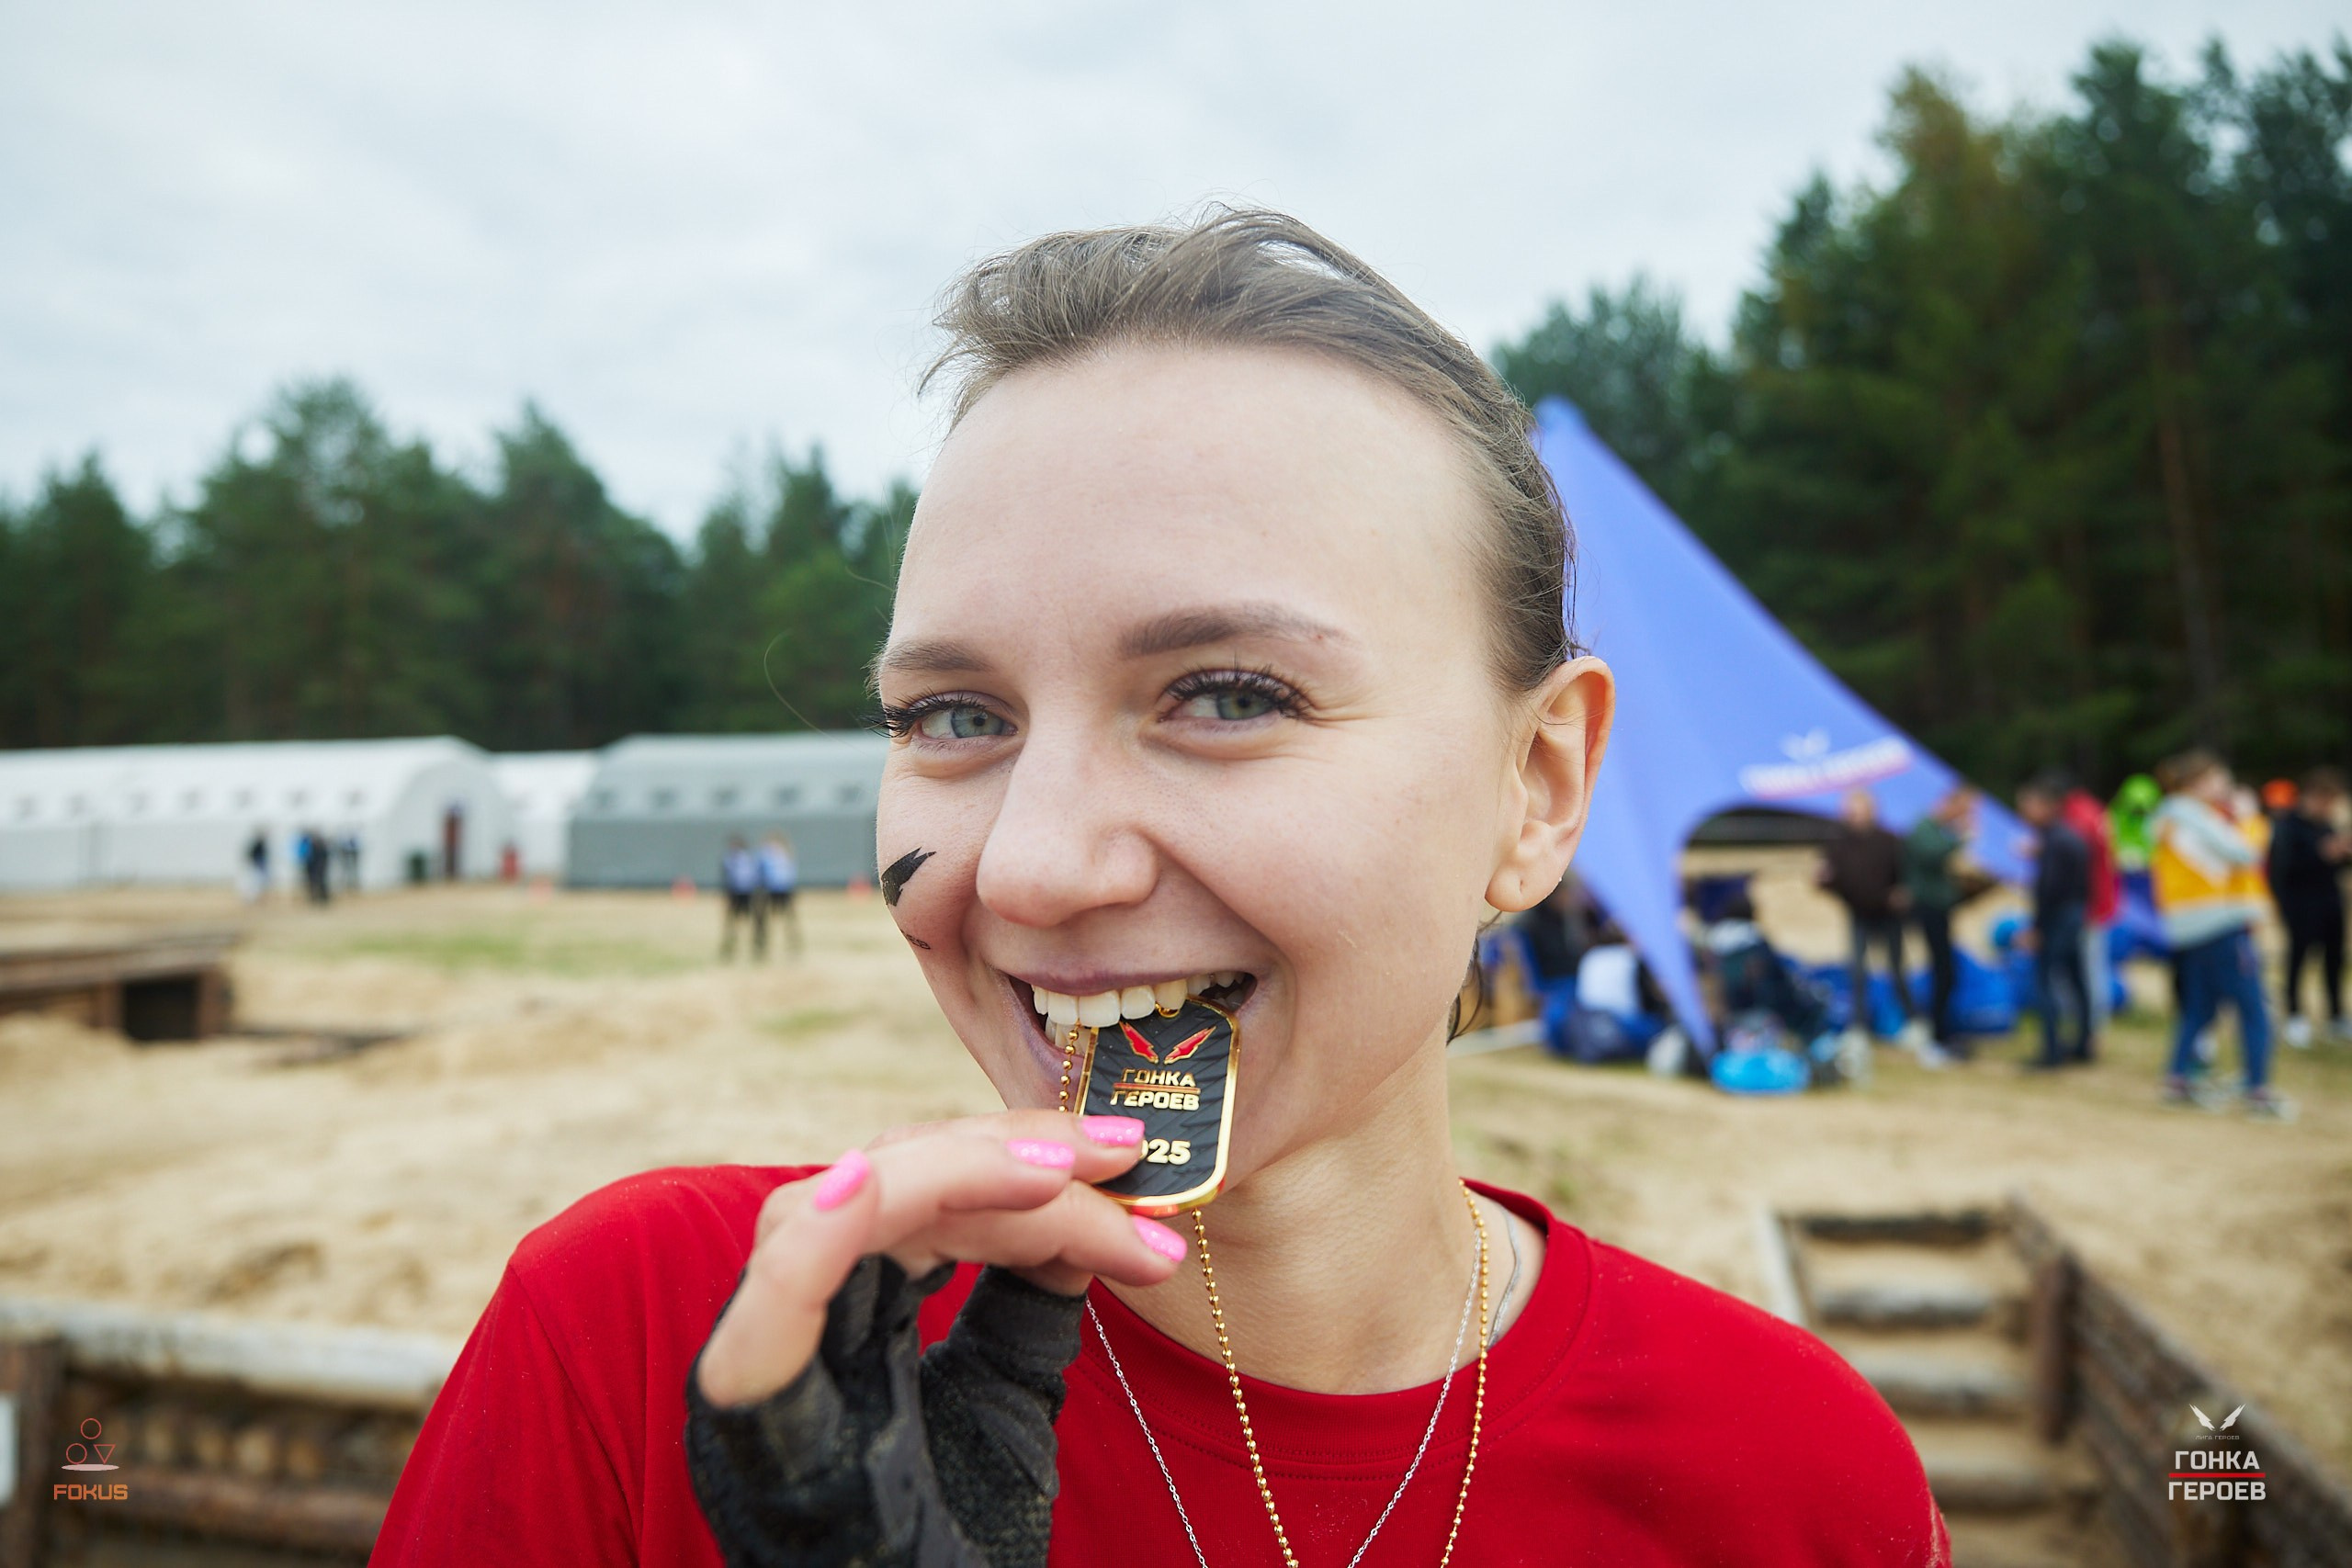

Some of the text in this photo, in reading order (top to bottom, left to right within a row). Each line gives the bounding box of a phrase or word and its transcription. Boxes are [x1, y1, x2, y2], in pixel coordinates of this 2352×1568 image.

[1122, 1068, 1196, 1087] ГОНКА
[1110, 1089, 1200, 1111] ГЕРОЕВ
[1139, 1139, 1192, 1165] 25
